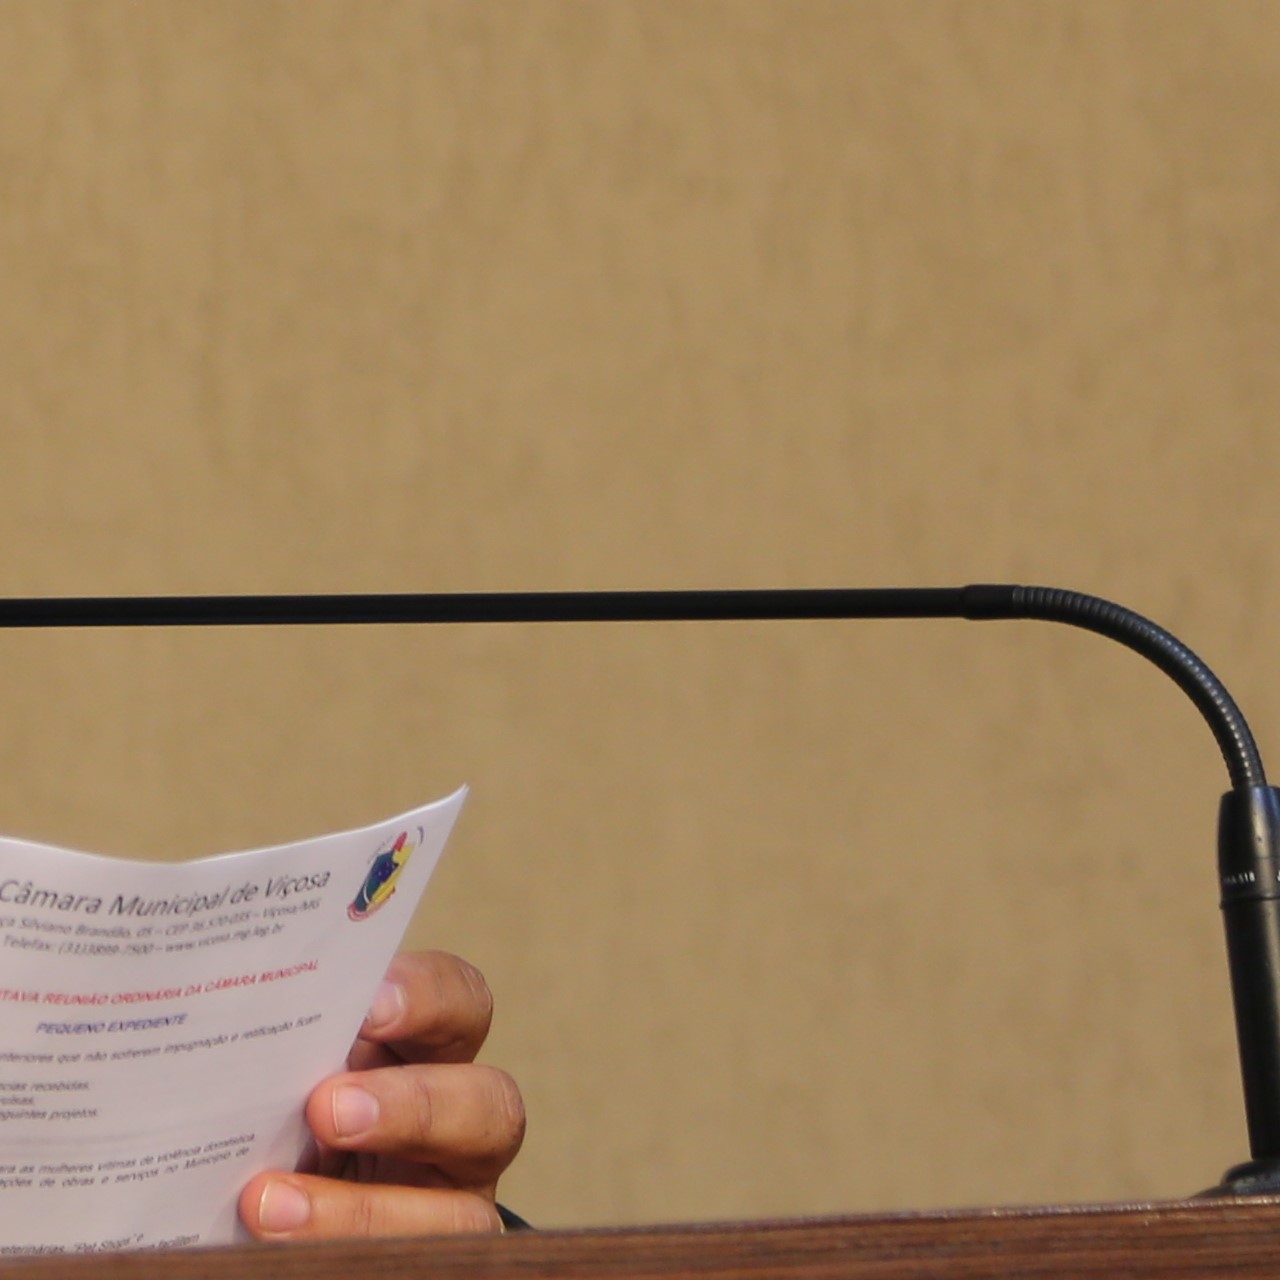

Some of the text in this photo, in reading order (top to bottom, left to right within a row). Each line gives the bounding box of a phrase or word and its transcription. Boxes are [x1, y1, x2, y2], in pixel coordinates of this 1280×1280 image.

[108, 884, 231, 918] Municipal
[230, 882, 258, 906] de
[266, 871, 331, 900] Viçosa
[185, 985, 202, 998] DA
[259, 960, 319, 984] MUNICIPAL
[36, 1013, 188, 1034] PEQUENO EXPEDIENTE
